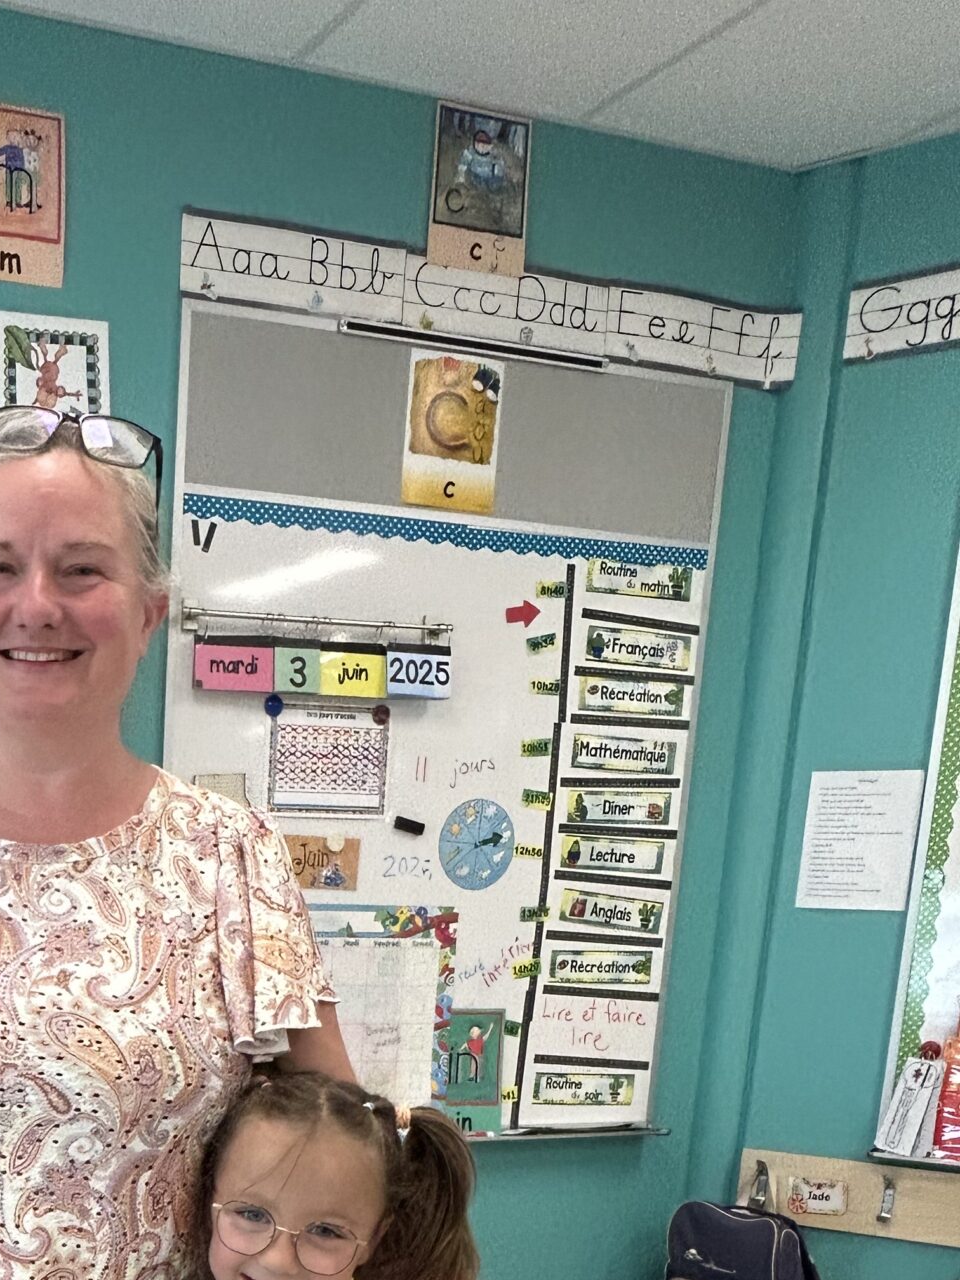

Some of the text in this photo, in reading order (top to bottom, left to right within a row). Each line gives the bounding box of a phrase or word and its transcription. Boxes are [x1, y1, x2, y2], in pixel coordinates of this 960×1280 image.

[600, 562, 638, 578] Routine
[641, 581, 670, 594] matin
[612, 638, 665, 659] Français
[210, 655, 450, 687] mardi 3 juin 2025
[601, 687, 662, 704] Récréation
[579, 741, 666, 764] Mathématique
[450, 759, 495, 788] jours
[590, 847, 635, 863] Lecture
[591, 902, 632, 923] Anglais
[570, 960, 631, 974] Récréation
[542, 998, 646, 1026] Lire et faire
[572, 1028, 609, 1051] lire
[546, 1076, 582, 1090] Routine
[585, 1091, 603, 1101] soir
[808, 1191, 830, 1201] Jade
